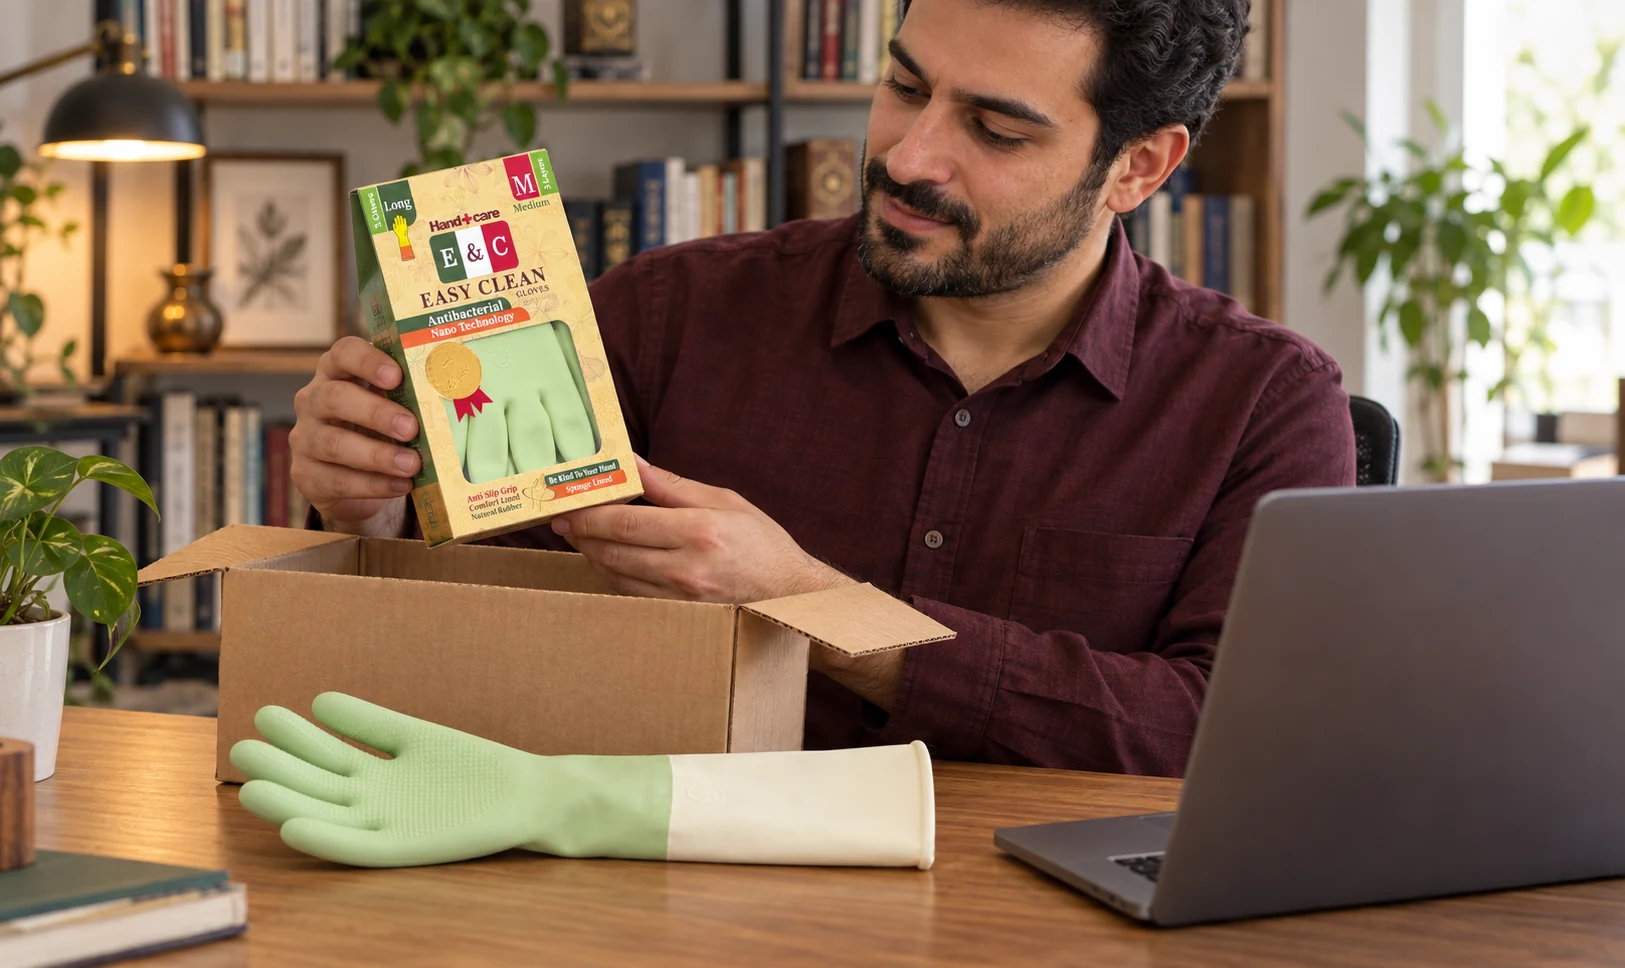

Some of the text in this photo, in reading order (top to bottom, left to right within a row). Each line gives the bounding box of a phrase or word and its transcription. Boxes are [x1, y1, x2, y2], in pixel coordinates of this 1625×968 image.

[511, 172, 536, 197] M
[383, 199, 413, 212] Long
[512, 199, 551, 213] Medium
[439, 247, 458, 269] E
[492, 235, 509, 256] C
[419, 266, 546, 309] EASY CLEAN
[428, 299, 504, 327] Antibacterial
[430, 312, 515, 339] Nano Technology
[484, 489, 500, 499] Slip
[500, 485, 518, 495] Grip
